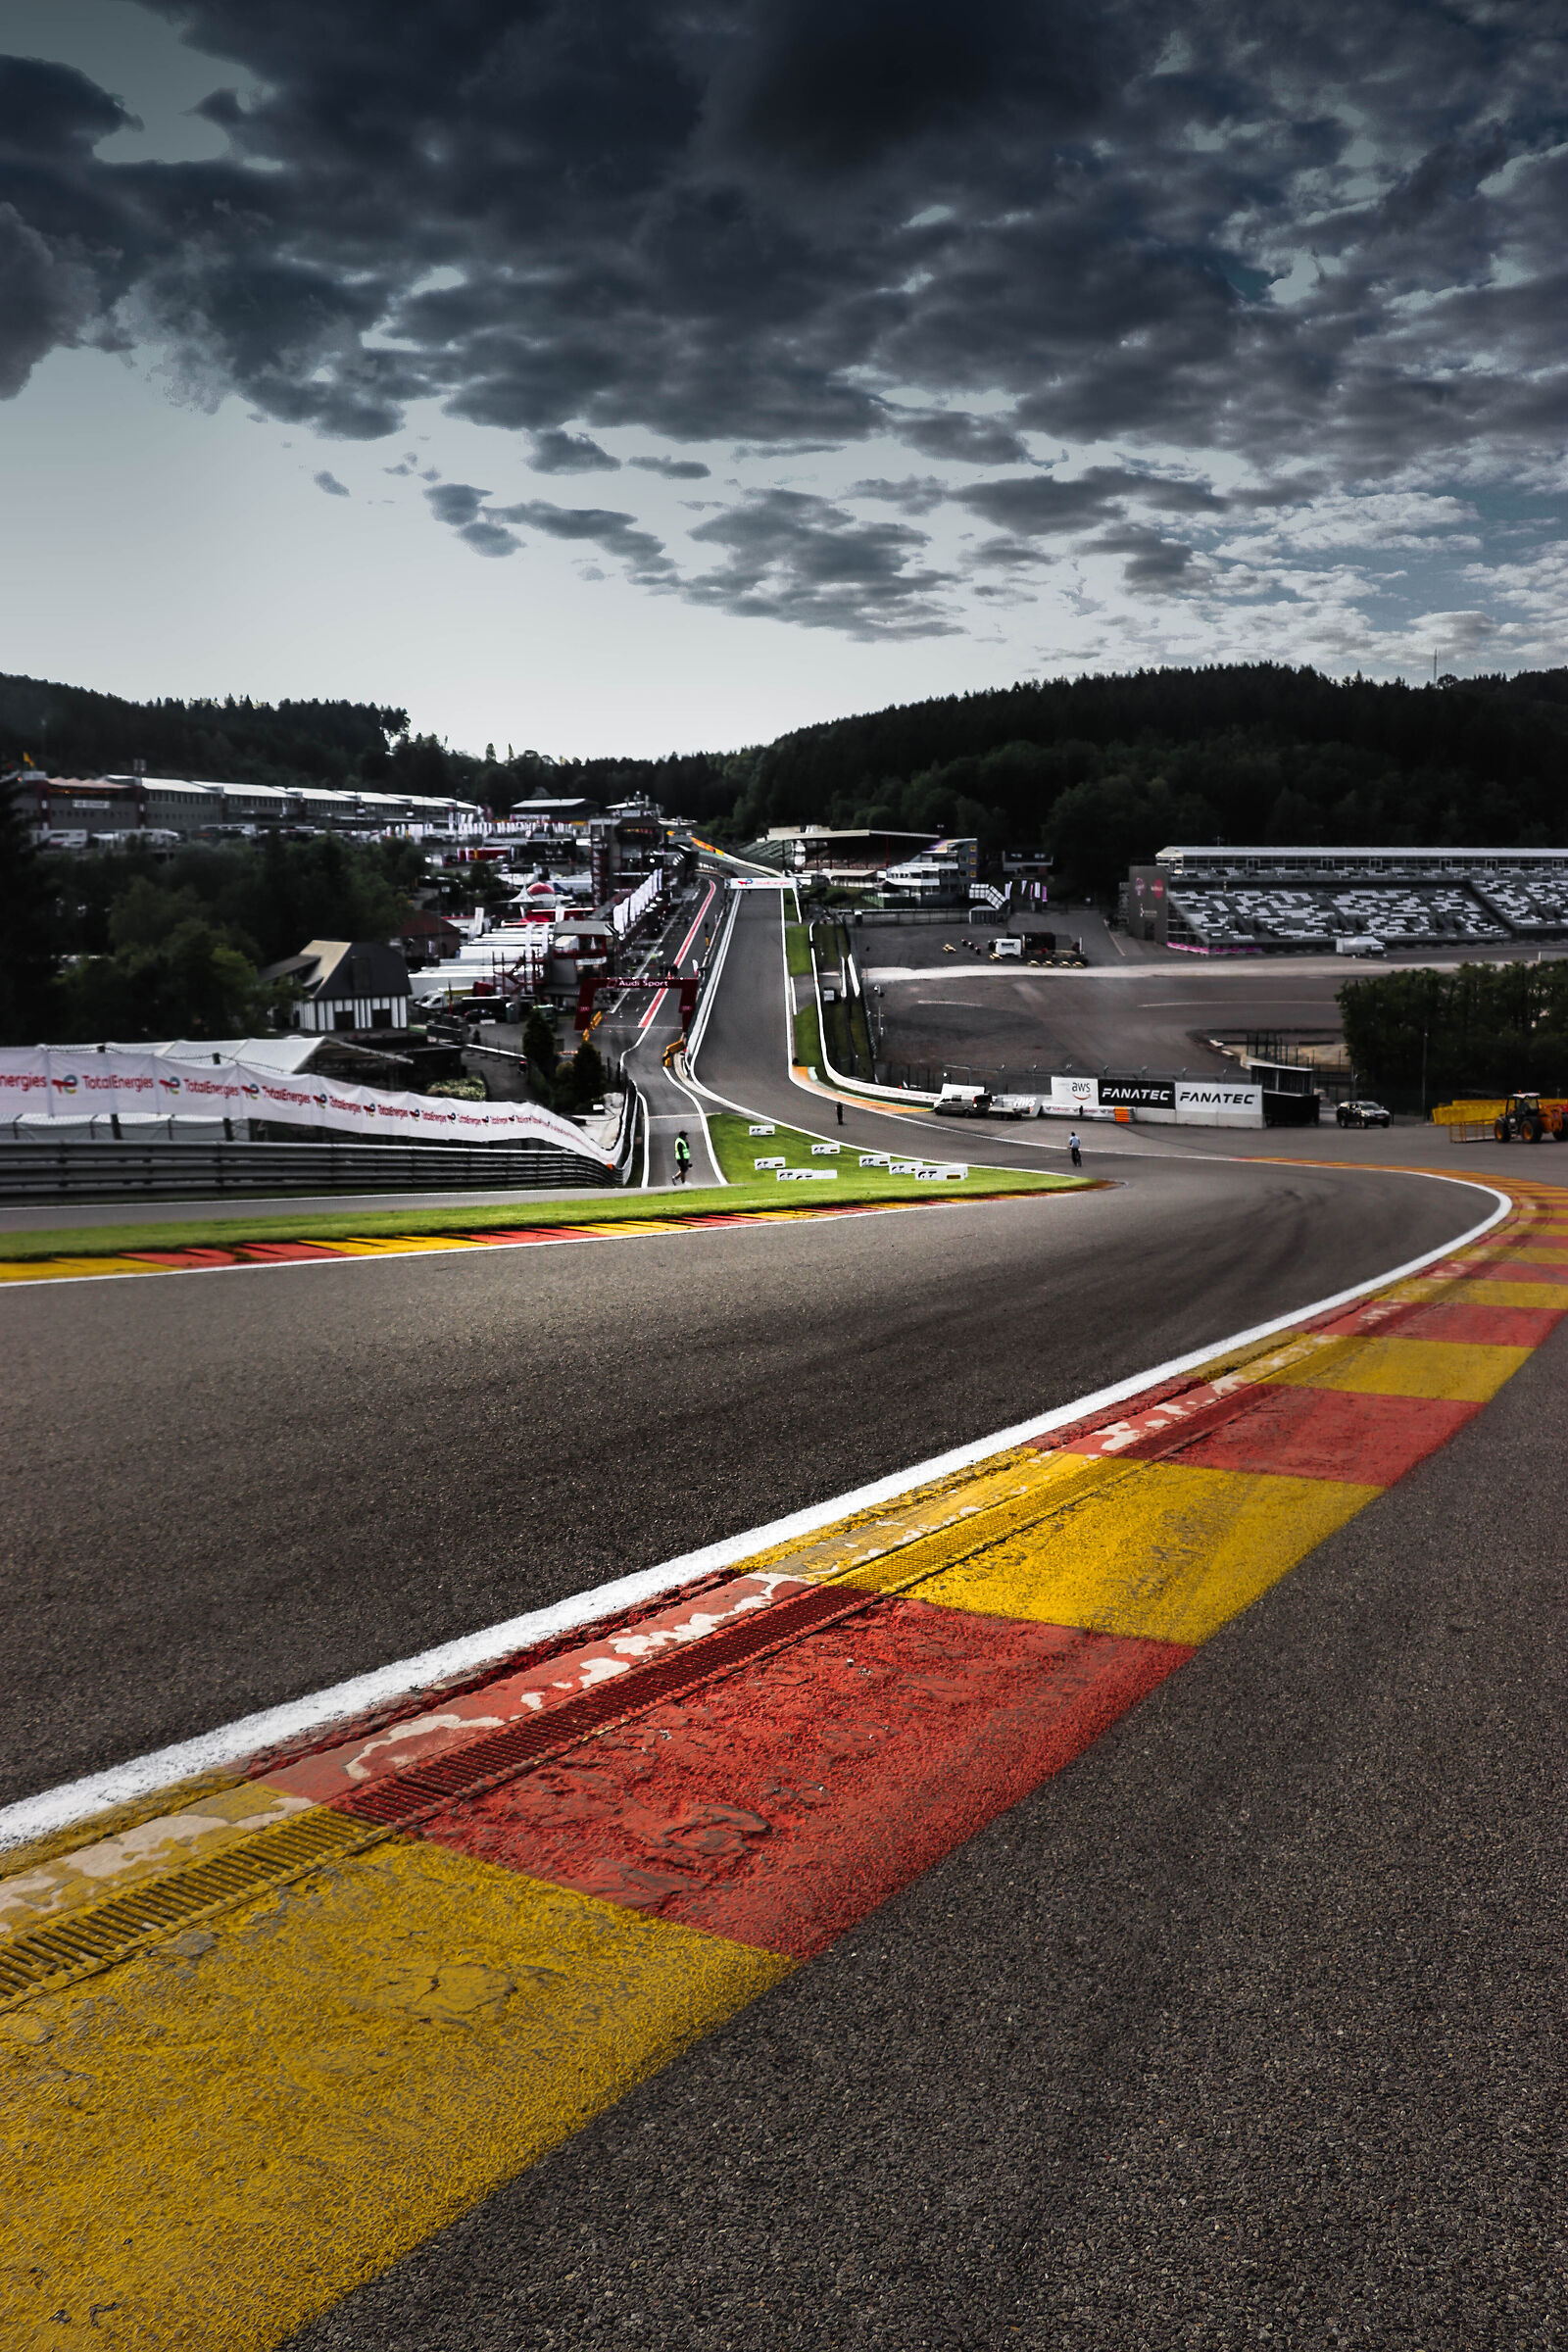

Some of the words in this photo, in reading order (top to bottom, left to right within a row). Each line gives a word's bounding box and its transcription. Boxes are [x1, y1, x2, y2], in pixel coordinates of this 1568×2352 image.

[81, 1074, 154, 1093] TotalEnergies
[183, 1078, 239, 1099] TotalEnergies
[262, 1085, 311, 1105] TotalEnergies
[1072, 1082, 1091, 1093] aws
[1102, 1088, 1170, 1101] FANATEC
[1180, 1092, 1254, 1104] FANATEC
